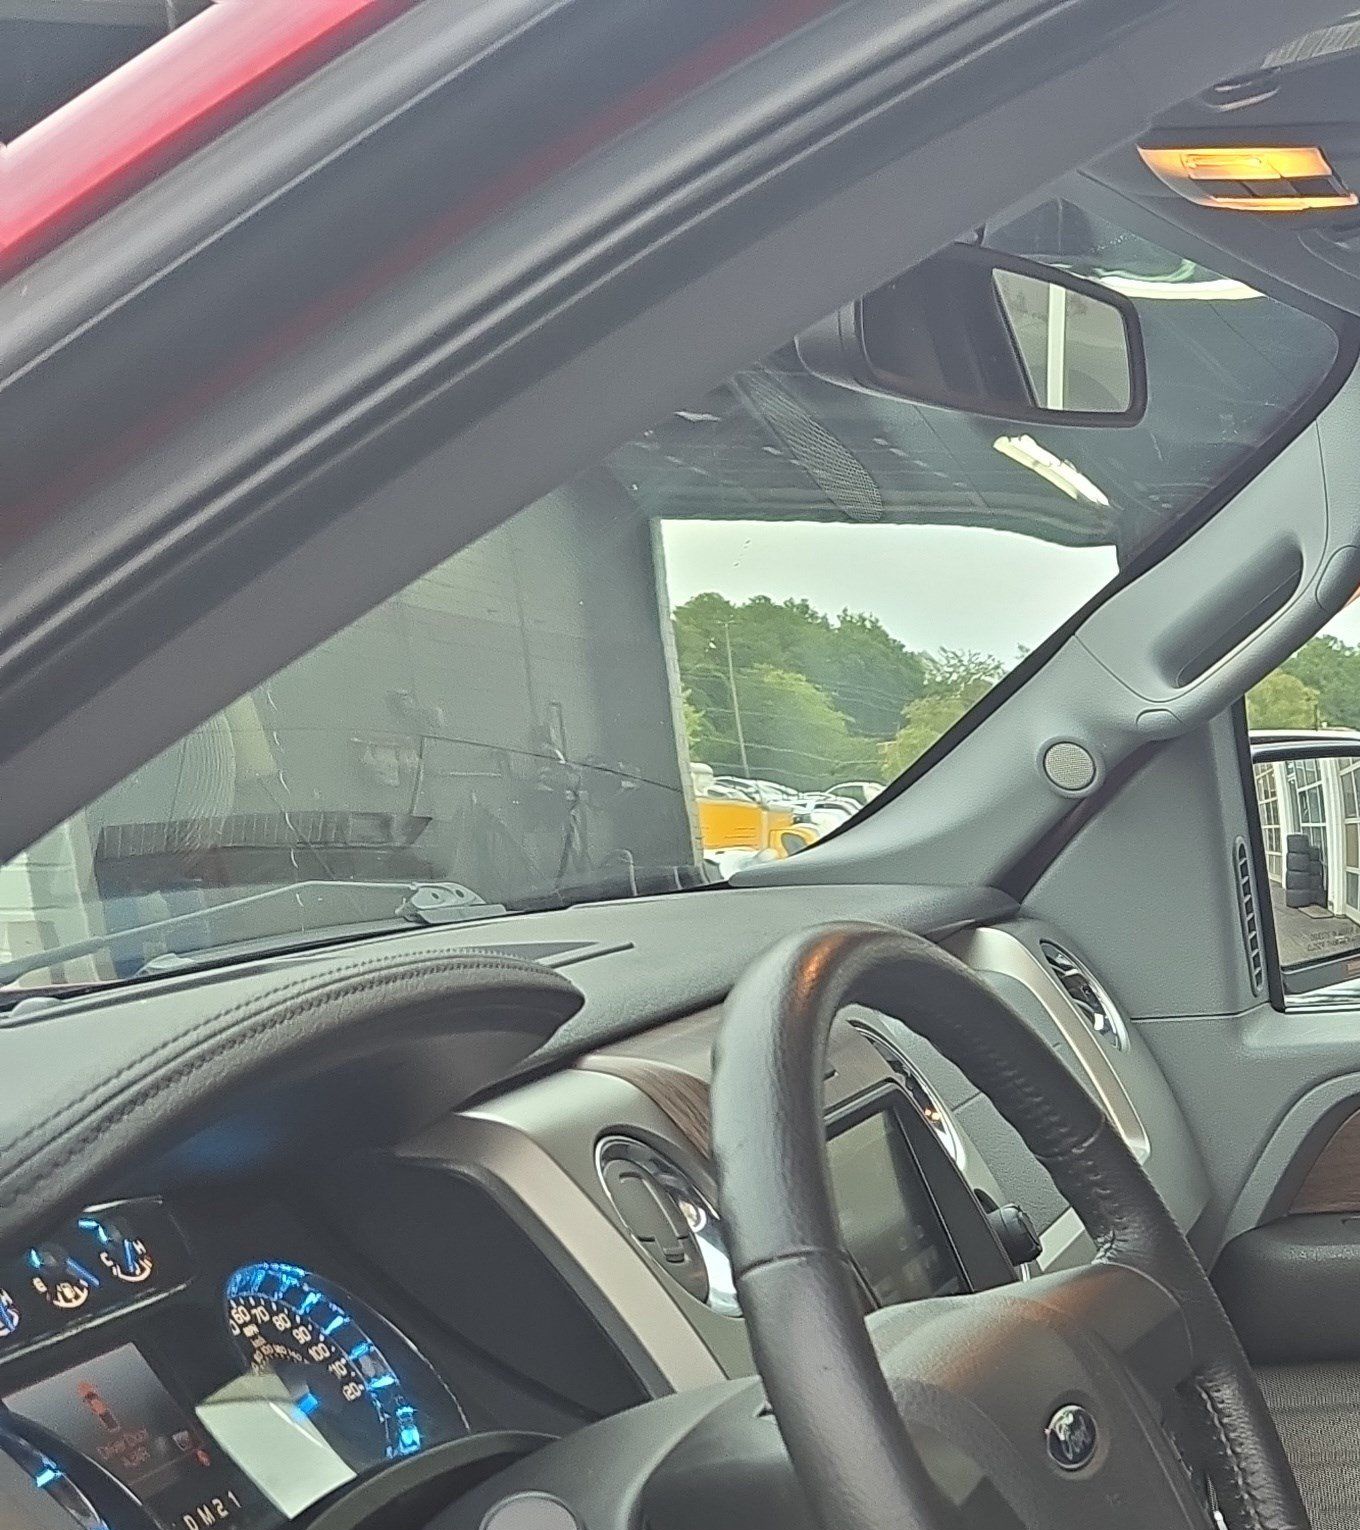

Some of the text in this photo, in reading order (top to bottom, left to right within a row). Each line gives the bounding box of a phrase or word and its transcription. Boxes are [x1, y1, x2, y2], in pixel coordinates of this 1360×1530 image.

[231, 1306, 251, 1324] 60
[251, 1306, 270, 1323] 70
[272, 1313, 291, 1331] 80
[292, 1326, 312, 1344] 90
[308, 1343, 331, 1361] 100
